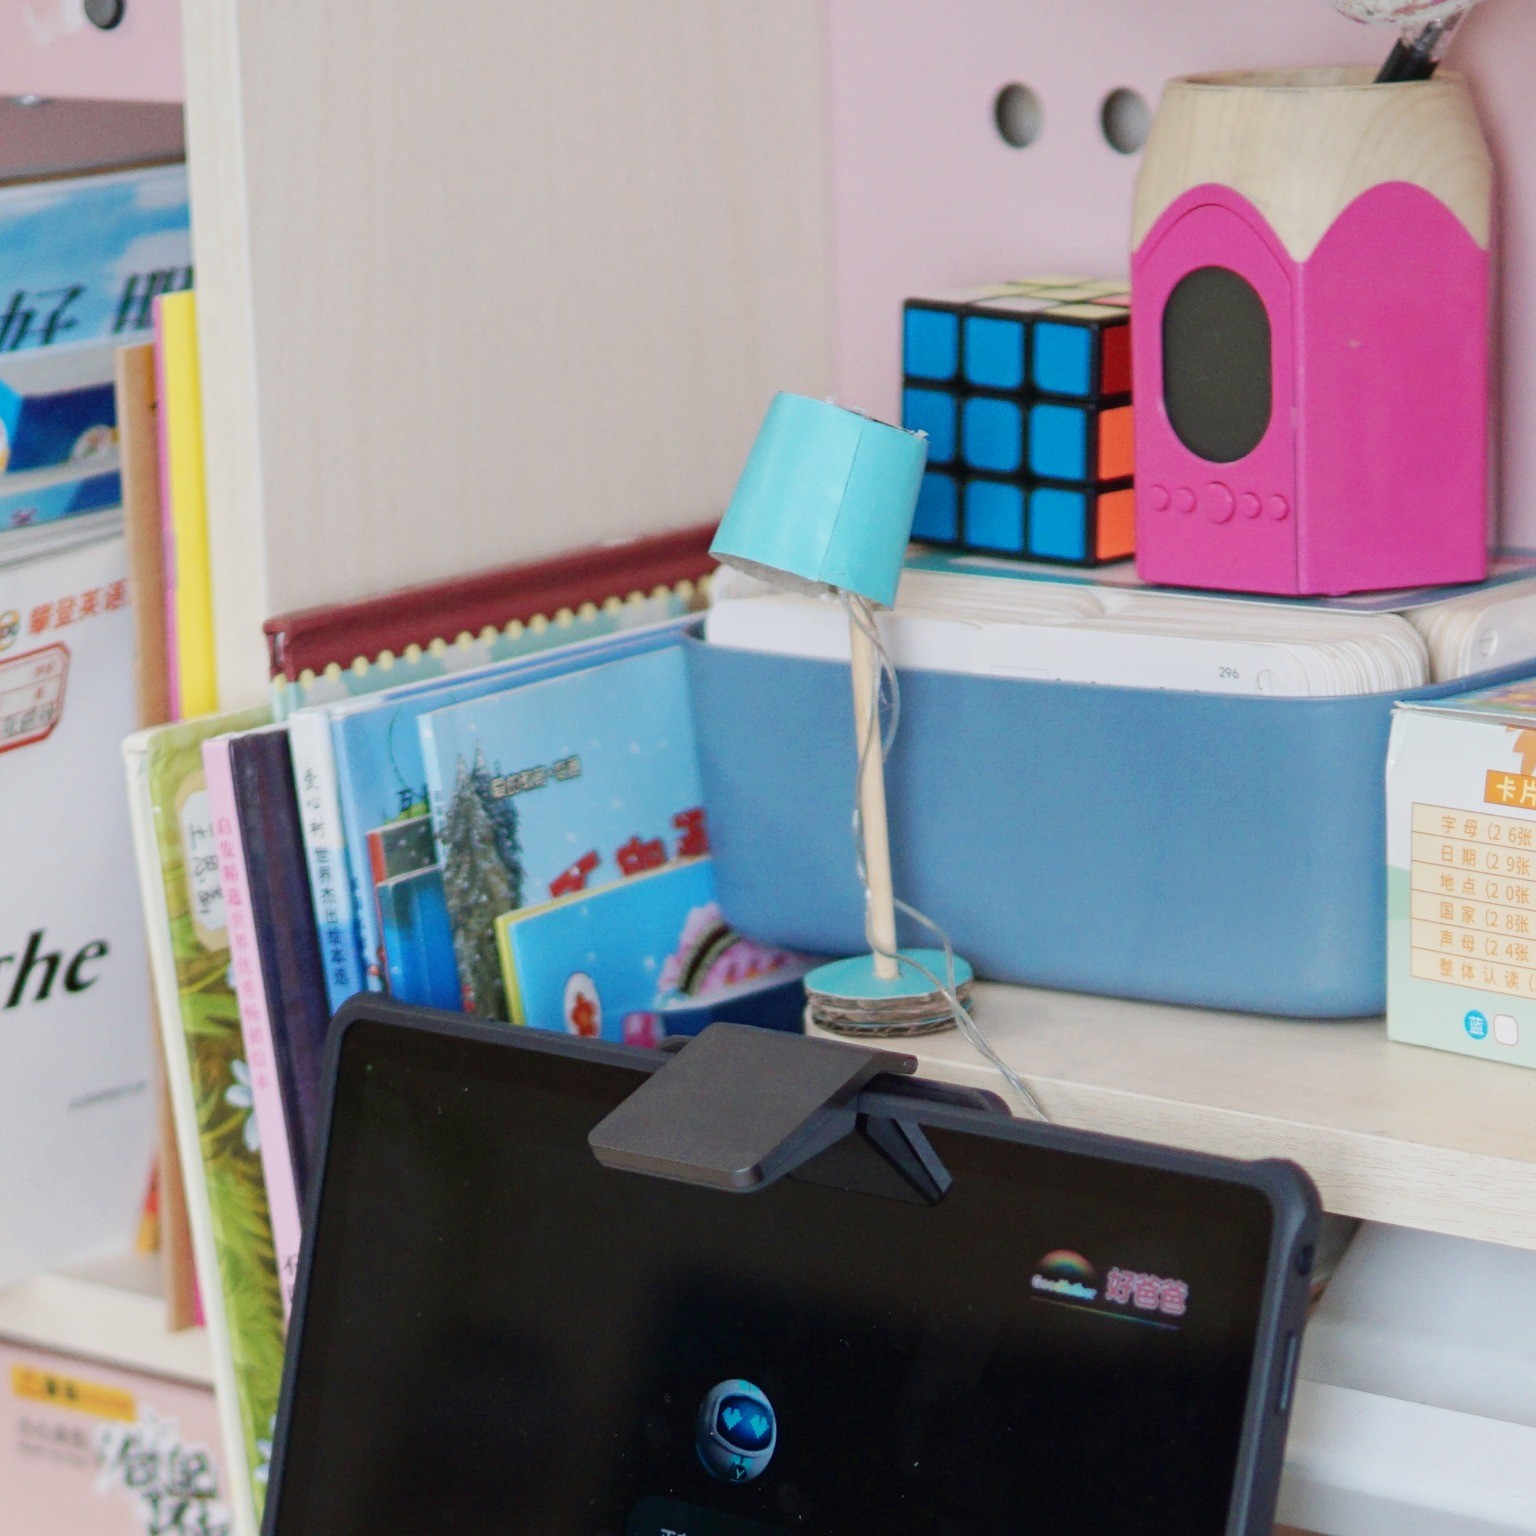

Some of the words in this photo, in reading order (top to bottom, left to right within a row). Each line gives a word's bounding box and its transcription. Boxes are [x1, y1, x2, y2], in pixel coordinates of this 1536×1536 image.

[1219, 666, 1240, 679] 296
[1105, 1266, 1189, 1316] 好爸爸
